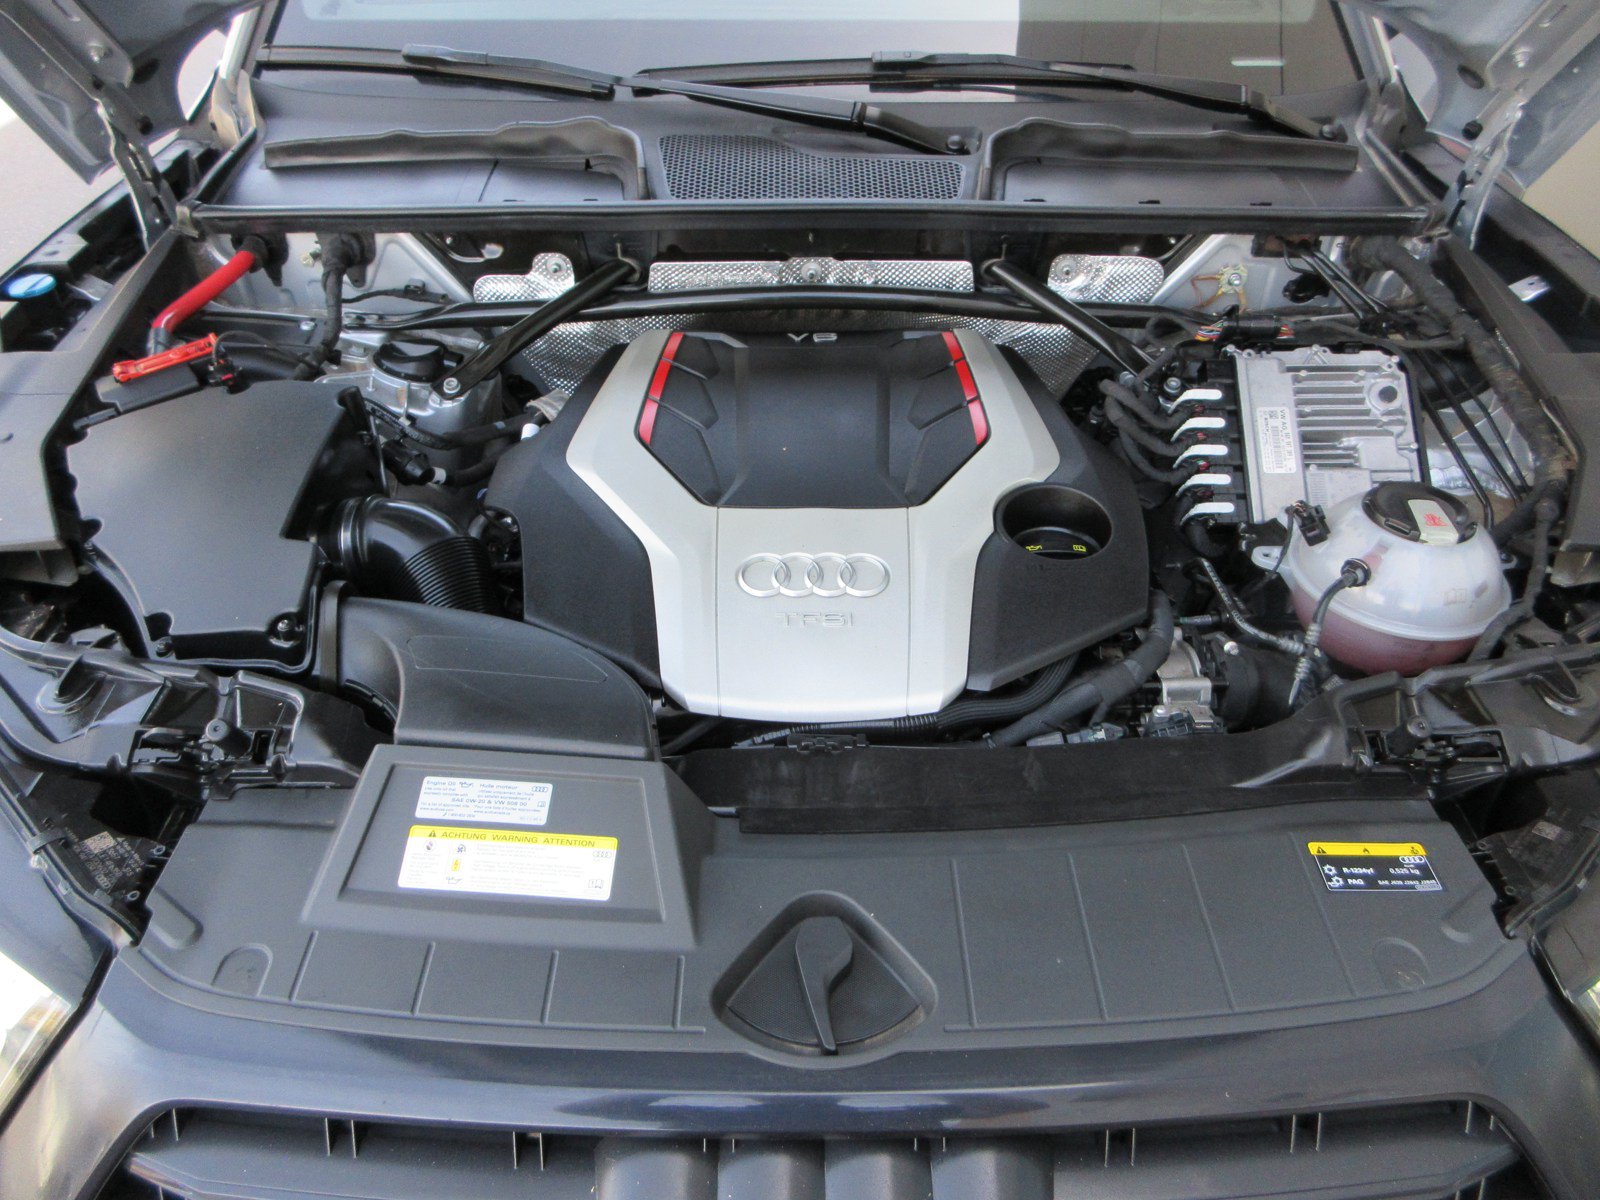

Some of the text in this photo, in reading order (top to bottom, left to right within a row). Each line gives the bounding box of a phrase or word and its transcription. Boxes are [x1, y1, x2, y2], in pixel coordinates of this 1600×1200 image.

[787, 332, 838, 343] V6
[776, 611, 854, 627] TFSI
[441, 831, 596, 848] ACHTUNG WARNING ATTENTION
